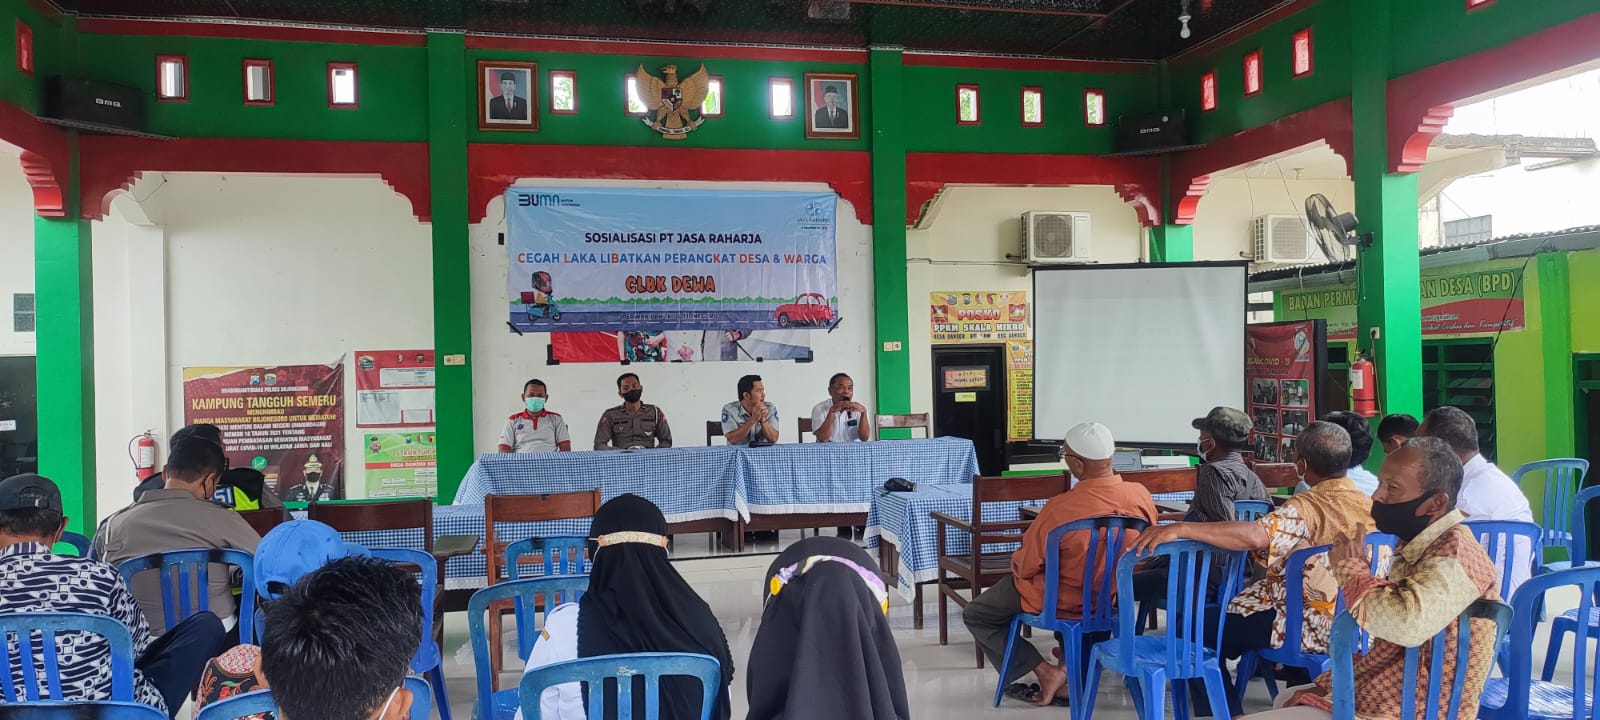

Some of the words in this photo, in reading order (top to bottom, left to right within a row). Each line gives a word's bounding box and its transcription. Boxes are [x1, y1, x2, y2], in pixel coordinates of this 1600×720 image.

[585, 232, 656, 243] SOSIALISASI
[660, 233, 673, 243] PT
[677, 233, 706, 244] JASA
[709, 233, 762, 244] RAHARJA
[518, 253, 560, 264] CEGAH
[564, 253, 597, 264] LAKA
[600, 253, 661, 264] LIBATKAN
[664, 253, 736, 264] PERANGKAT
[739, 253, 770, 264] DESA
[773, 253, 781, 264] &
[784, 253, 827, 265] WARGA
[625, 275, 668, 294] CLBK
[671, 275, 716, 293] DEWA
[1440, 275, 1475, 298] DESA
[1478, 271, 1515, 297] (BPD)
[1288, 294, 1321, 311] BADAN
[957, 309, 1001, 321] POSKO
[934, 323, 960, 332] PPKM
[963, 323, 992, 332] SKALA
[996, 322, 1024, 331] MIKRO
[192, 397, 244, 410] KAMPUNG
[246, 396, 294, 409] TANGGUH
[296, 394, 337, 408] SEMERU
[193, 417, 215, 425] WARGA
[215, 416, 252, 424] MASYARAKAT
[252, 415, 288, 423] BOJONEGORO
[282, 428, 305, 436] TENTANG
